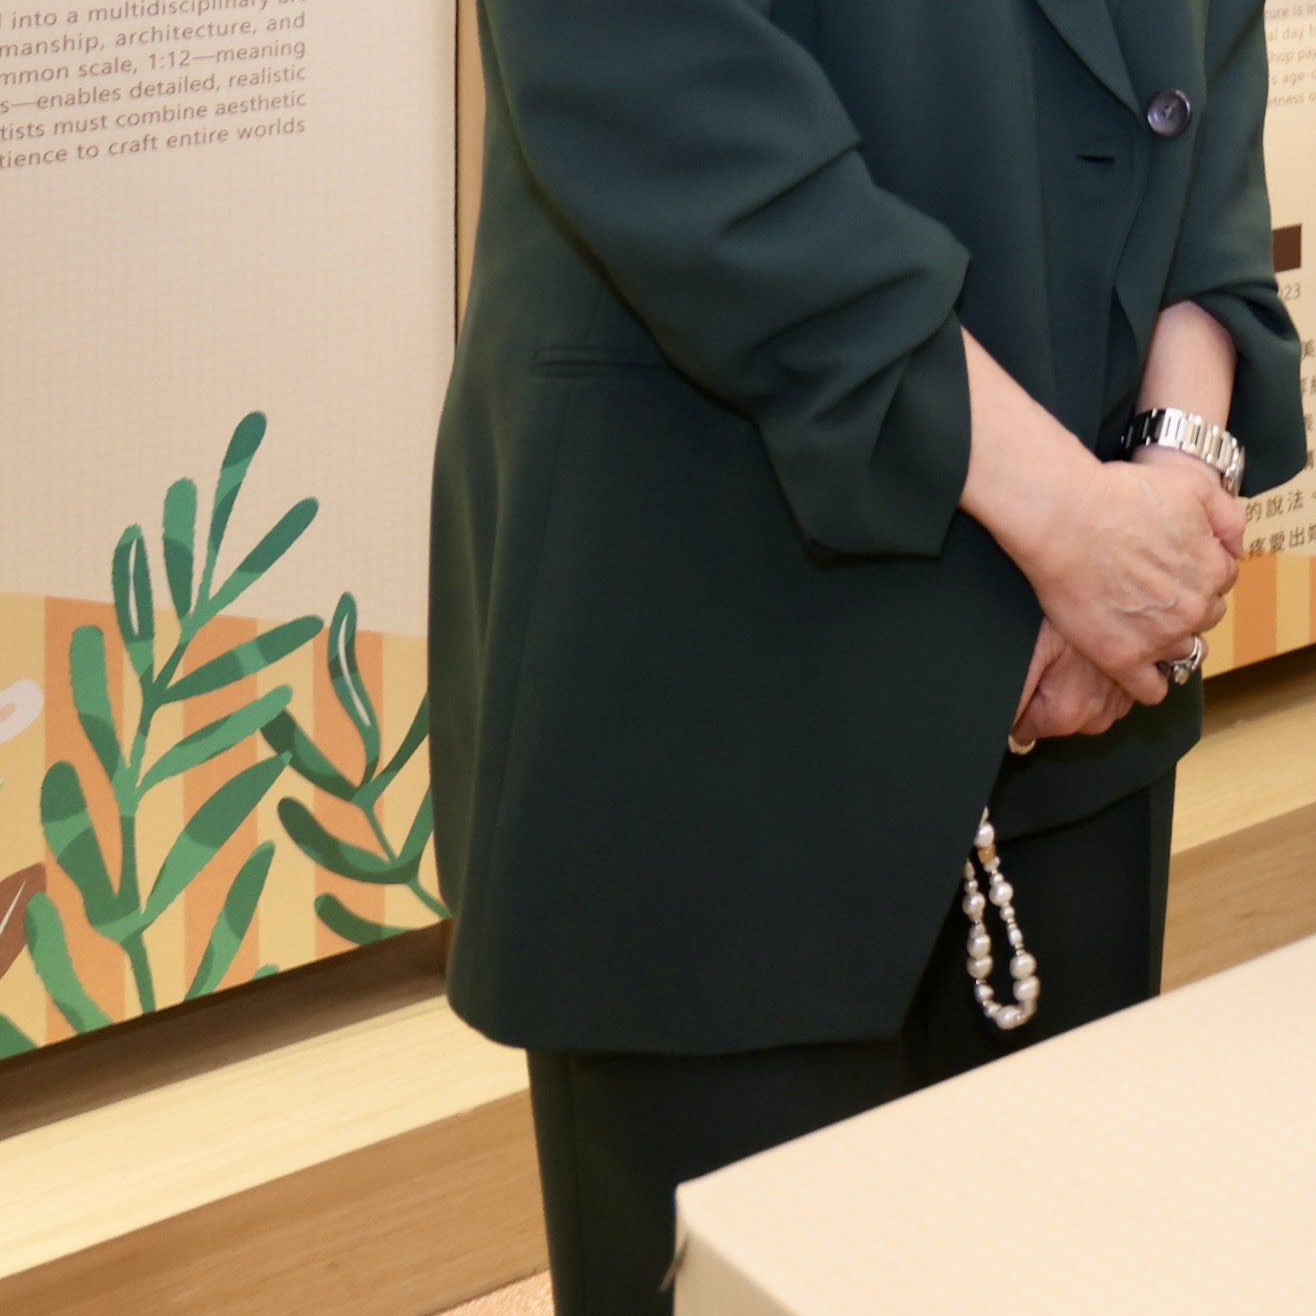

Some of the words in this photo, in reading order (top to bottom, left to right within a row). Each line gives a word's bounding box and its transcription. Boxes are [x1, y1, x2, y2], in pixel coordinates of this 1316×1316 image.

[12, 11, 57, 29] into
[67, 10, 78, 24] a
[1293, 4, 1303, 17] is
[0, 33, 104, 58] manship,
[116, 20, 257, 47] architecture,
[267, 11, 305, 31] and
[1282, 27, 1304, 41] day
[78, 57, 138, 78] scale,
[129, 72, 221, 100] detailed,
[228, 64, 306, 88] realistic
[54, 114, 108, 135] must
[115, 104, 208, 128] combine
[215, 90, 306, 117] aesthetic
[77, 144, 99, 160] to
[108, 133, 158, 156] craft
[166, 127, 229, 149] entire
[236, 117, 306, 140] worlds
